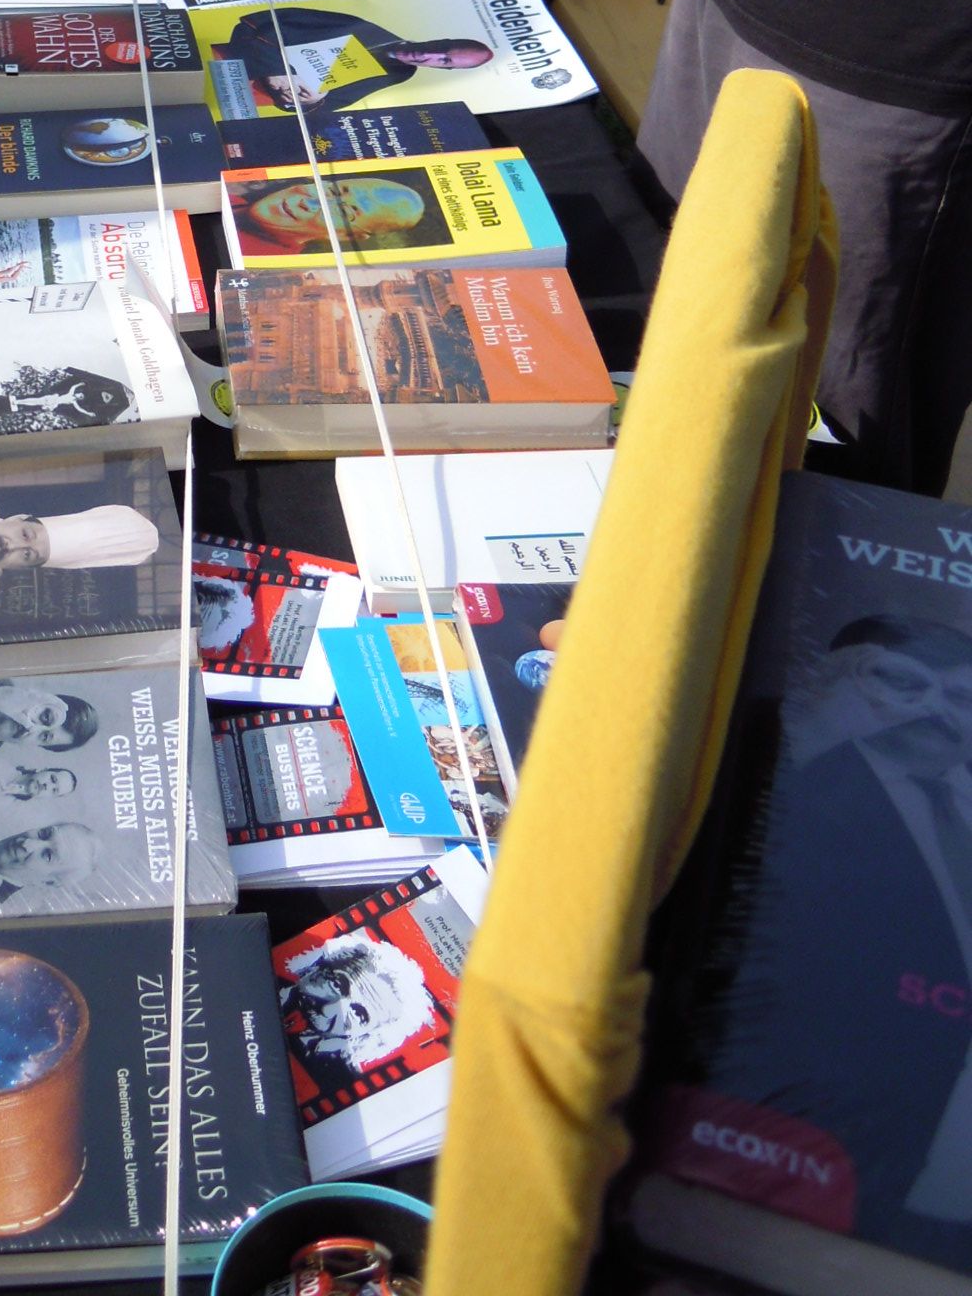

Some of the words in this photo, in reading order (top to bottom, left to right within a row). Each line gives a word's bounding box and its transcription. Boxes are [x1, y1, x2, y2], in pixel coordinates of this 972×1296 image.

[31, 14, 68, 64] WAHN
[62, 12, 102, 68] GOTTES
[98, 27, 116, 43] DER
[140, 10, 176, 68] DAWKINS
[164, 14, 191, 59] RICHARD
[19, 119, 35, 144] RICHARD
[361, 118, 375, 129] des
[379, 115, 393, 127] Das
[0, 142, 20, 174] blinde
[23, 146, 40, 180] DAWKINS
[432, 164, 449, 176] Fall
[456, 161, 492, 190] Dalai
[437, 177, 453, 194] eines
[127, 221, 146, 238] Die
[444, 194, 468, 232] Gottkönigs
[471, 192, 502, 227] Lama
[464, 277, 494, 322] Muslim
[481, 325, 503, 345] bin
[490, 277, 515, 321] Warum
[548, 290, 563, 314] Warraq
[504, 323, 528, 342] ich
[127, 318, 149, 345] Jonah
[139, 347, 165, 403] Goldhagen
[511, 345, 536, 374] kein
[131, 687, 156, 751] WEISS,
[108, 735, 138, 829] GLAUBEN
[138, 754, 165, 811] MUSS
[213, 739, 237, 824] www.rabenhof.at
[275, 744, 300, 811] BUSTERS
[293, 726, 327, 797] SCIENCE
[399, 792, 427, 824] GWUP
[144, 816, 173, 883] ALLES
[436, 916, 452, 934] Prof.
[433, 942, 444, 957] Ing.
[136, 974, 171, 1076] ZUFALL
[241, 1010, 256, 1040] Heinz
[182, 1041, 214, 1098] DAS
[246, 1042, 267, 1115] Oberhummer
[116, 1068, 136, 1160] Geheimnisvolles
[189, 1109, 228, 1200] ALLES
[123, 1163, 141, 1228] Universum
